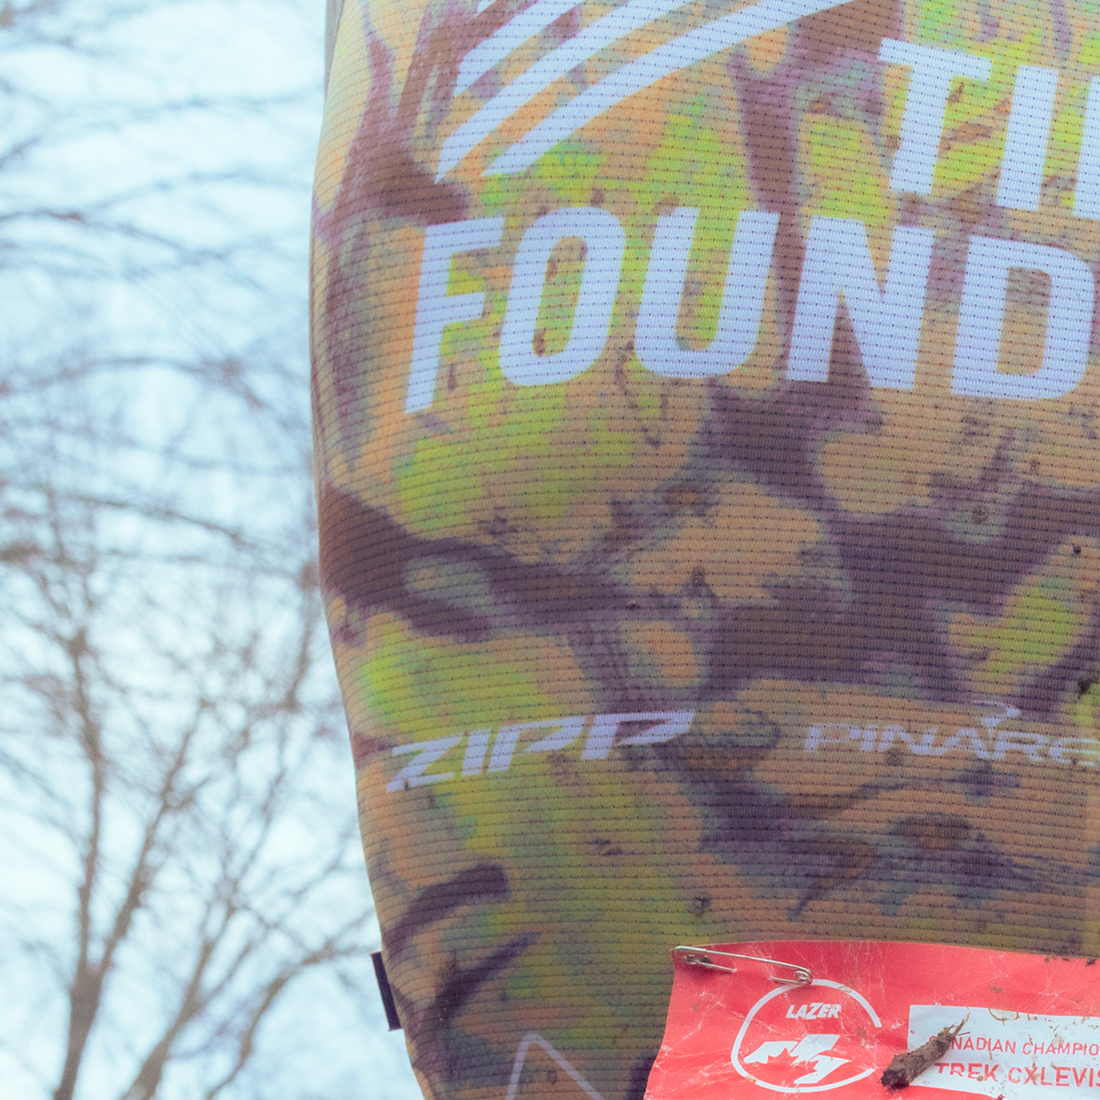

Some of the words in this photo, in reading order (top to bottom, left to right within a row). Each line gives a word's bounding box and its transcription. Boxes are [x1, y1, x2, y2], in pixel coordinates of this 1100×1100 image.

[386, 709, 696, 793] ZIPP
[785, 1002, 842, 1020] LAZER
[929, 1034, 1017, 1057] NADIAN
[934, 1062, 999, 1083] TREK
